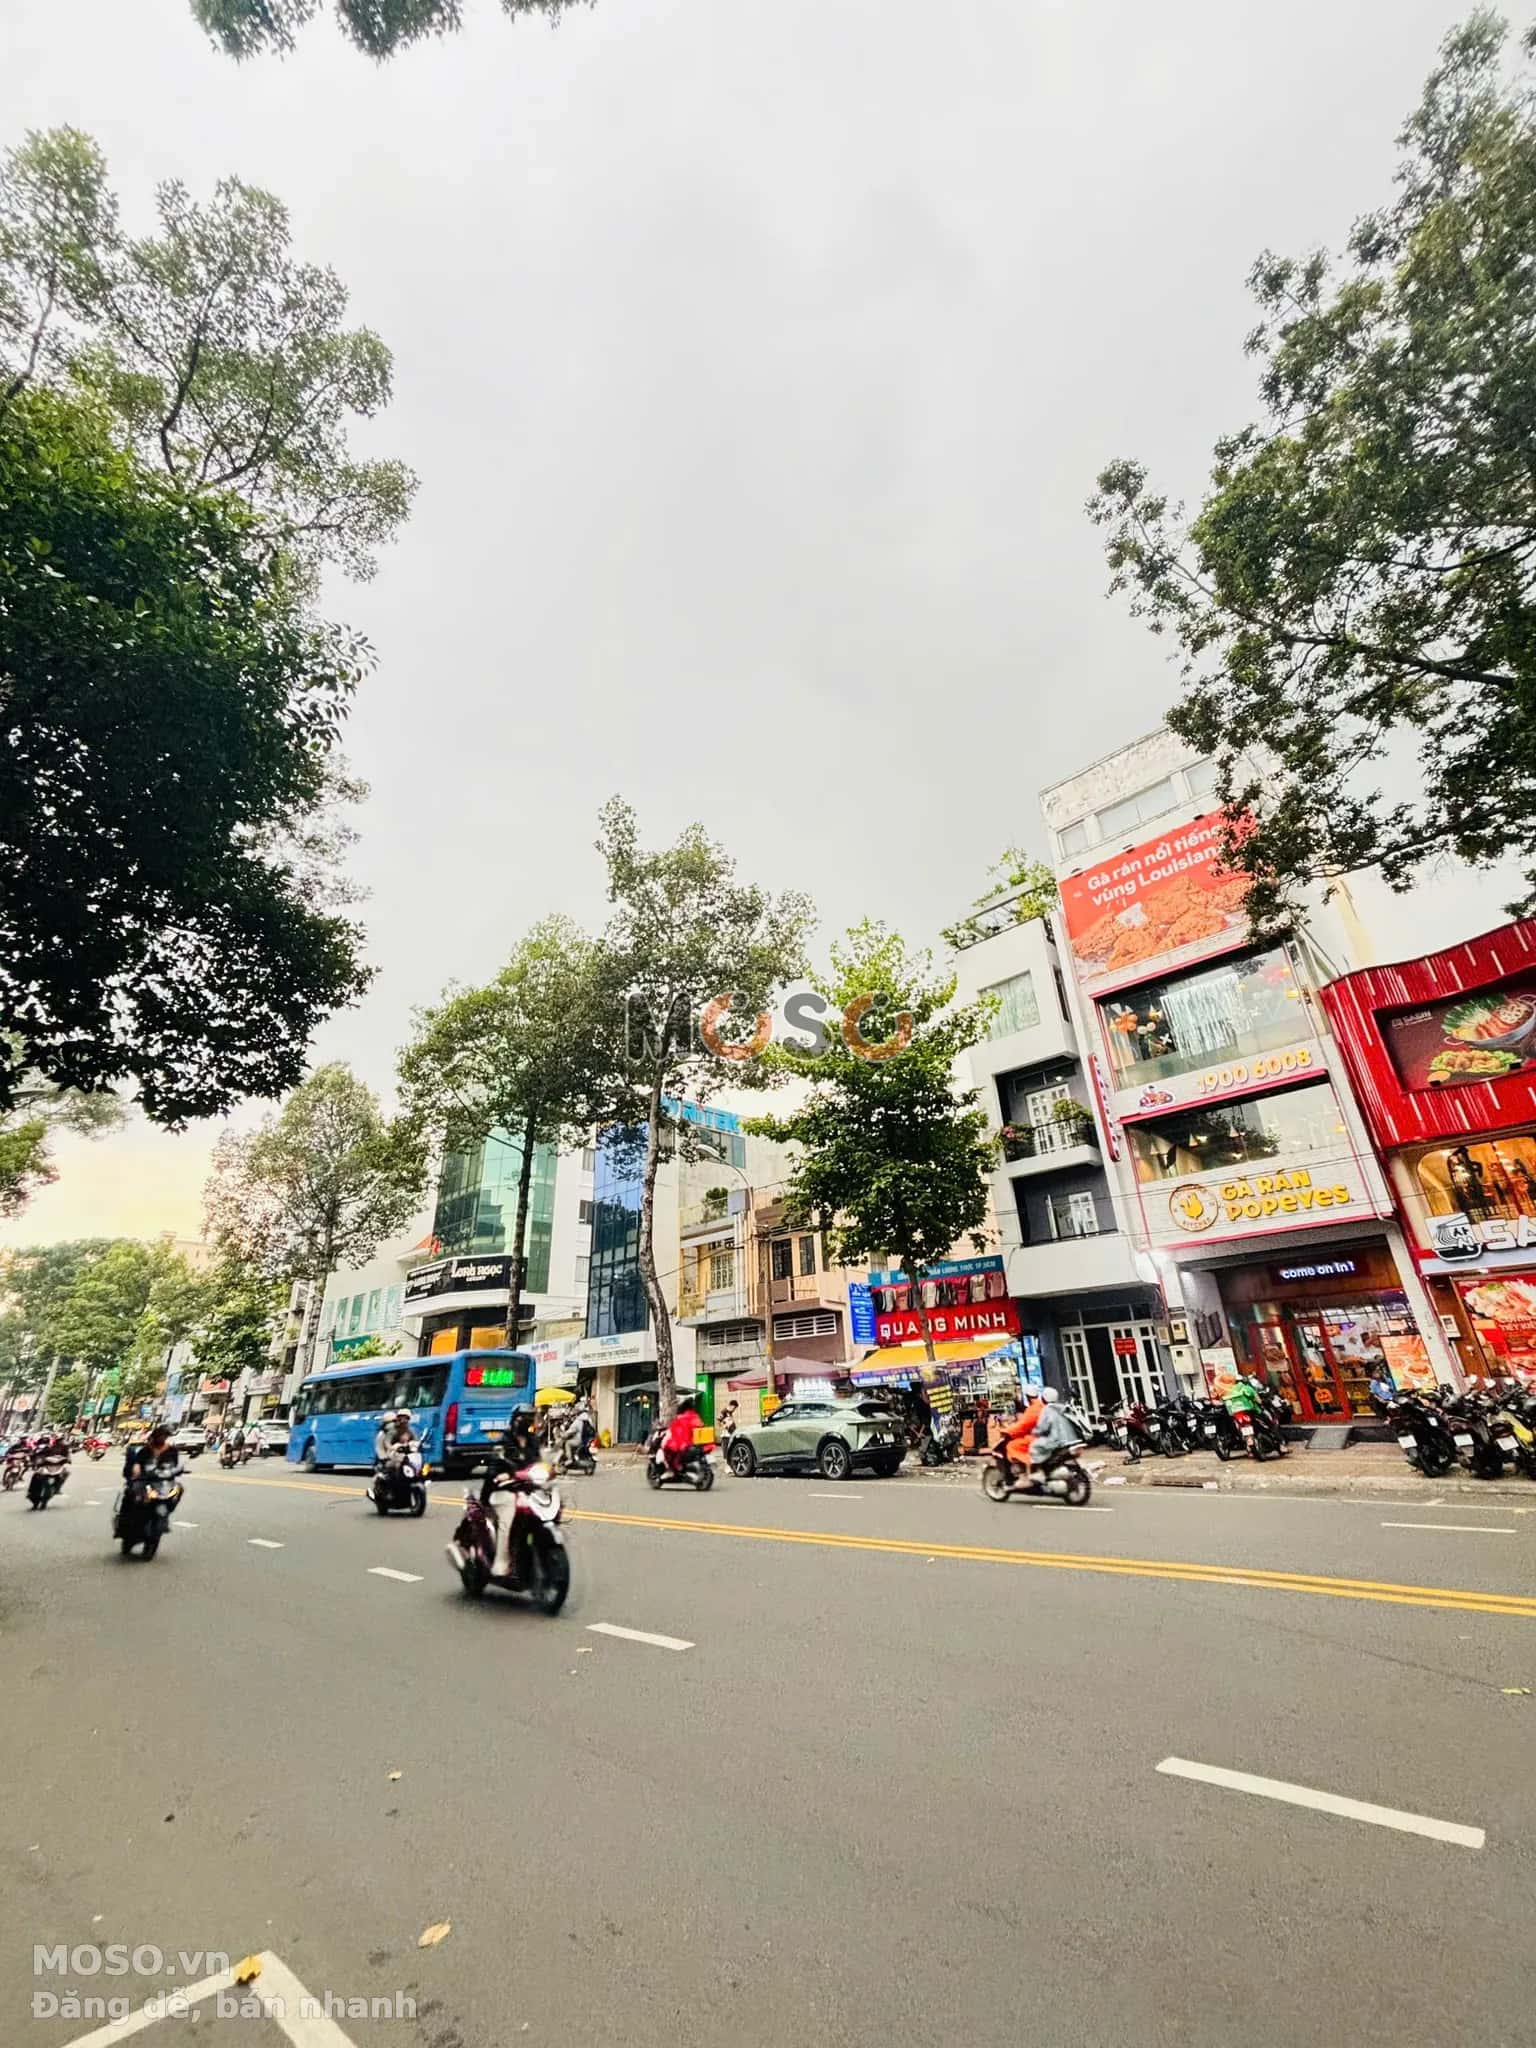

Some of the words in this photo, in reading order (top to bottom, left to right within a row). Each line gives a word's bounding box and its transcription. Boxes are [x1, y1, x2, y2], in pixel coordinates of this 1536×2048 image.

[1087, 867, 1111, 892] Gà
[1113, 856, 1142, 880] rán
[1144, 839, 1172, 868] nổi
[1091, 876, 1137, 909] vùng
[1139, 844, 1226, 887] Louisian
[1199, 1063, 1249, 1094] 1900
[1253, 1047, 1313, 1079] 6008
[1219, 1176, 1256, 1201] GÀ
[1256, 1167, 1312, 1195] RÁN
[1280, 1266, 1315, 1280] come
[1316, 1263, 1335, 1276] on
[954, 1311, 1007, 1331] MINH
